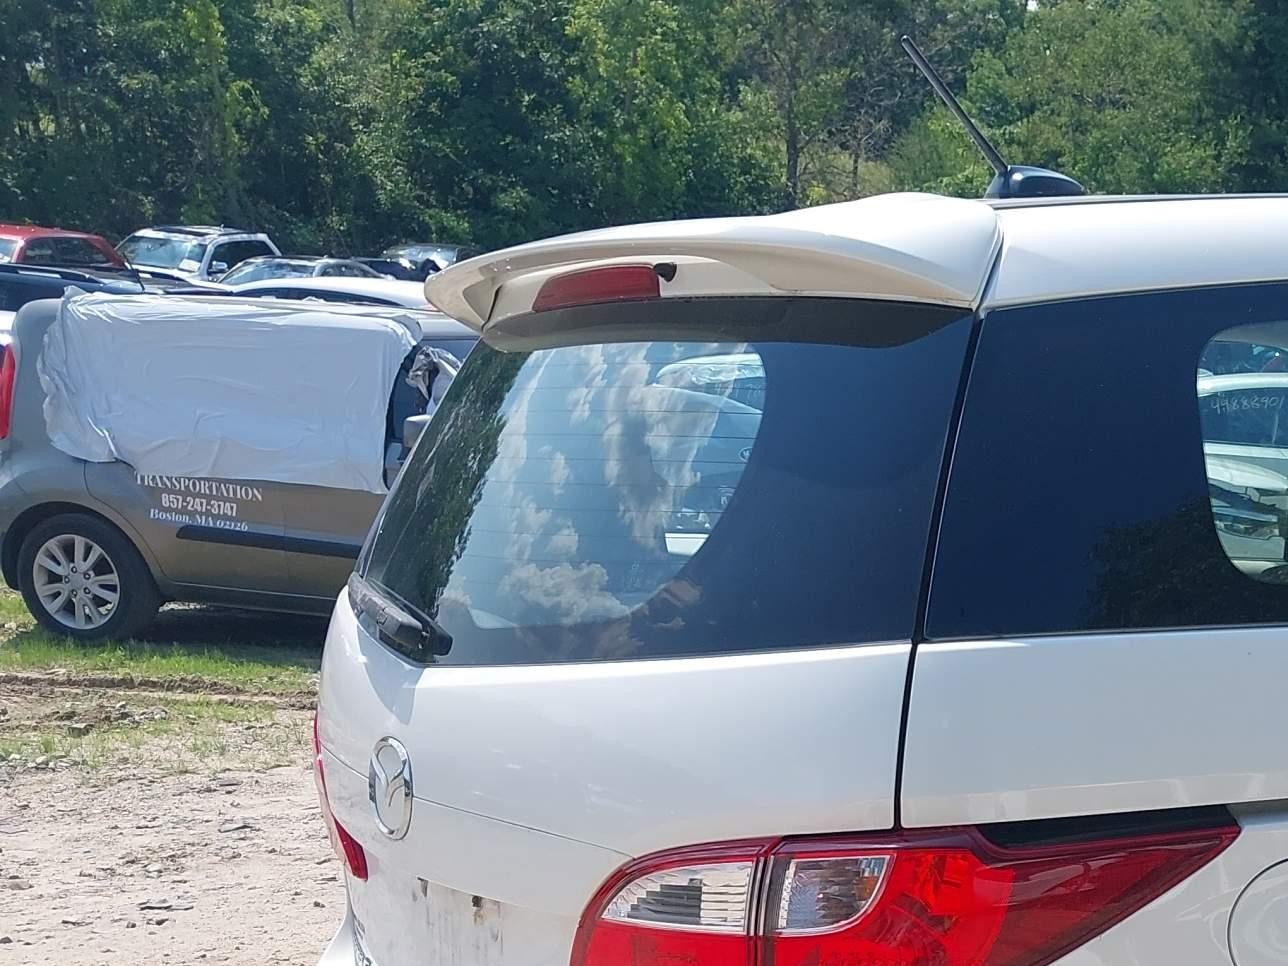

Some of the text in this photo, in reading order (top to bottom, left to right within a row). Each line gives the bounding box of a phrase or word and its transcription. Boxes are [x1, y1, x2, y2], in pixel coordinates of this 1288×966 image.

[134, 471, 263, 501] TRANSPORTATION
[161, 493, 237, 517] 857-247-3747
[196, 515, 214, 527] MA
[216, 519, 249, 532] 02126
